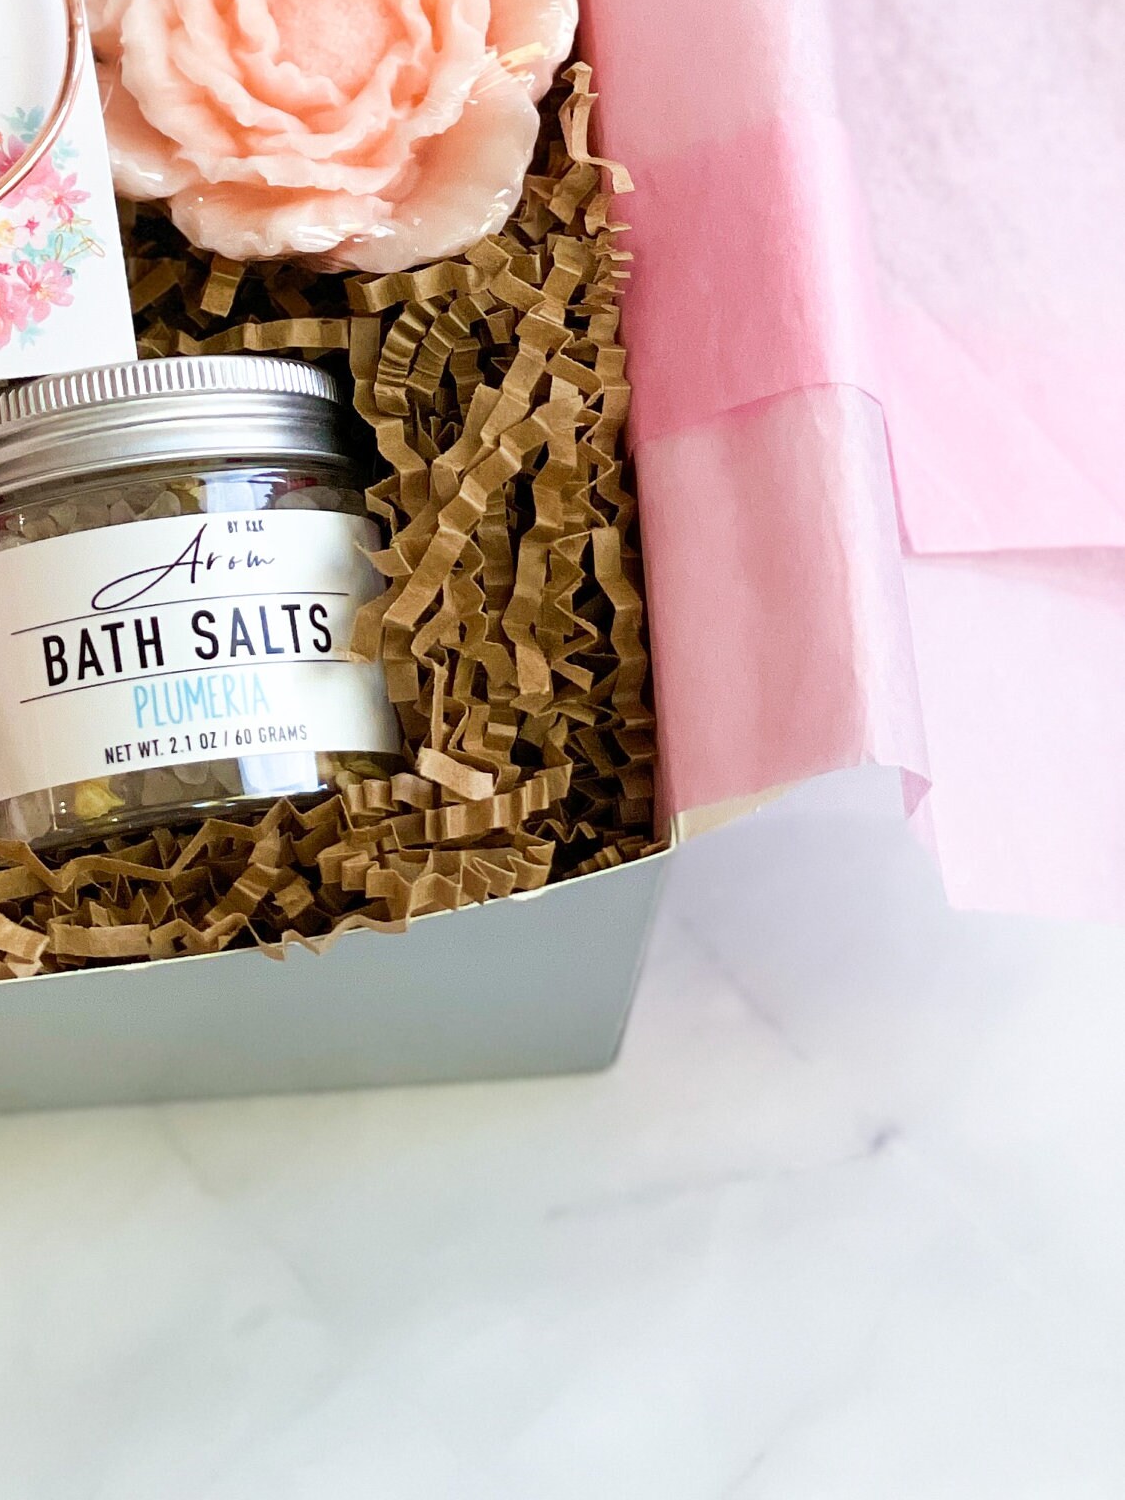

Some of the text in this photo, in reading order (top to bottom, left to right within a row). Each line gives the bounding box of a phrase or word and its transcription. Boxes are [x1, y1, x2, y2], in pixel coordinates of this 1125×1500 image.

[227, 520, 239, 533] BY
[43, 603, 333, 687] BATH SALTS
[133, 672, 271, 729] PLUMERIA
[105, 724, 308, 765] NET WT. 2.1 OZ / 60 GRAMS
